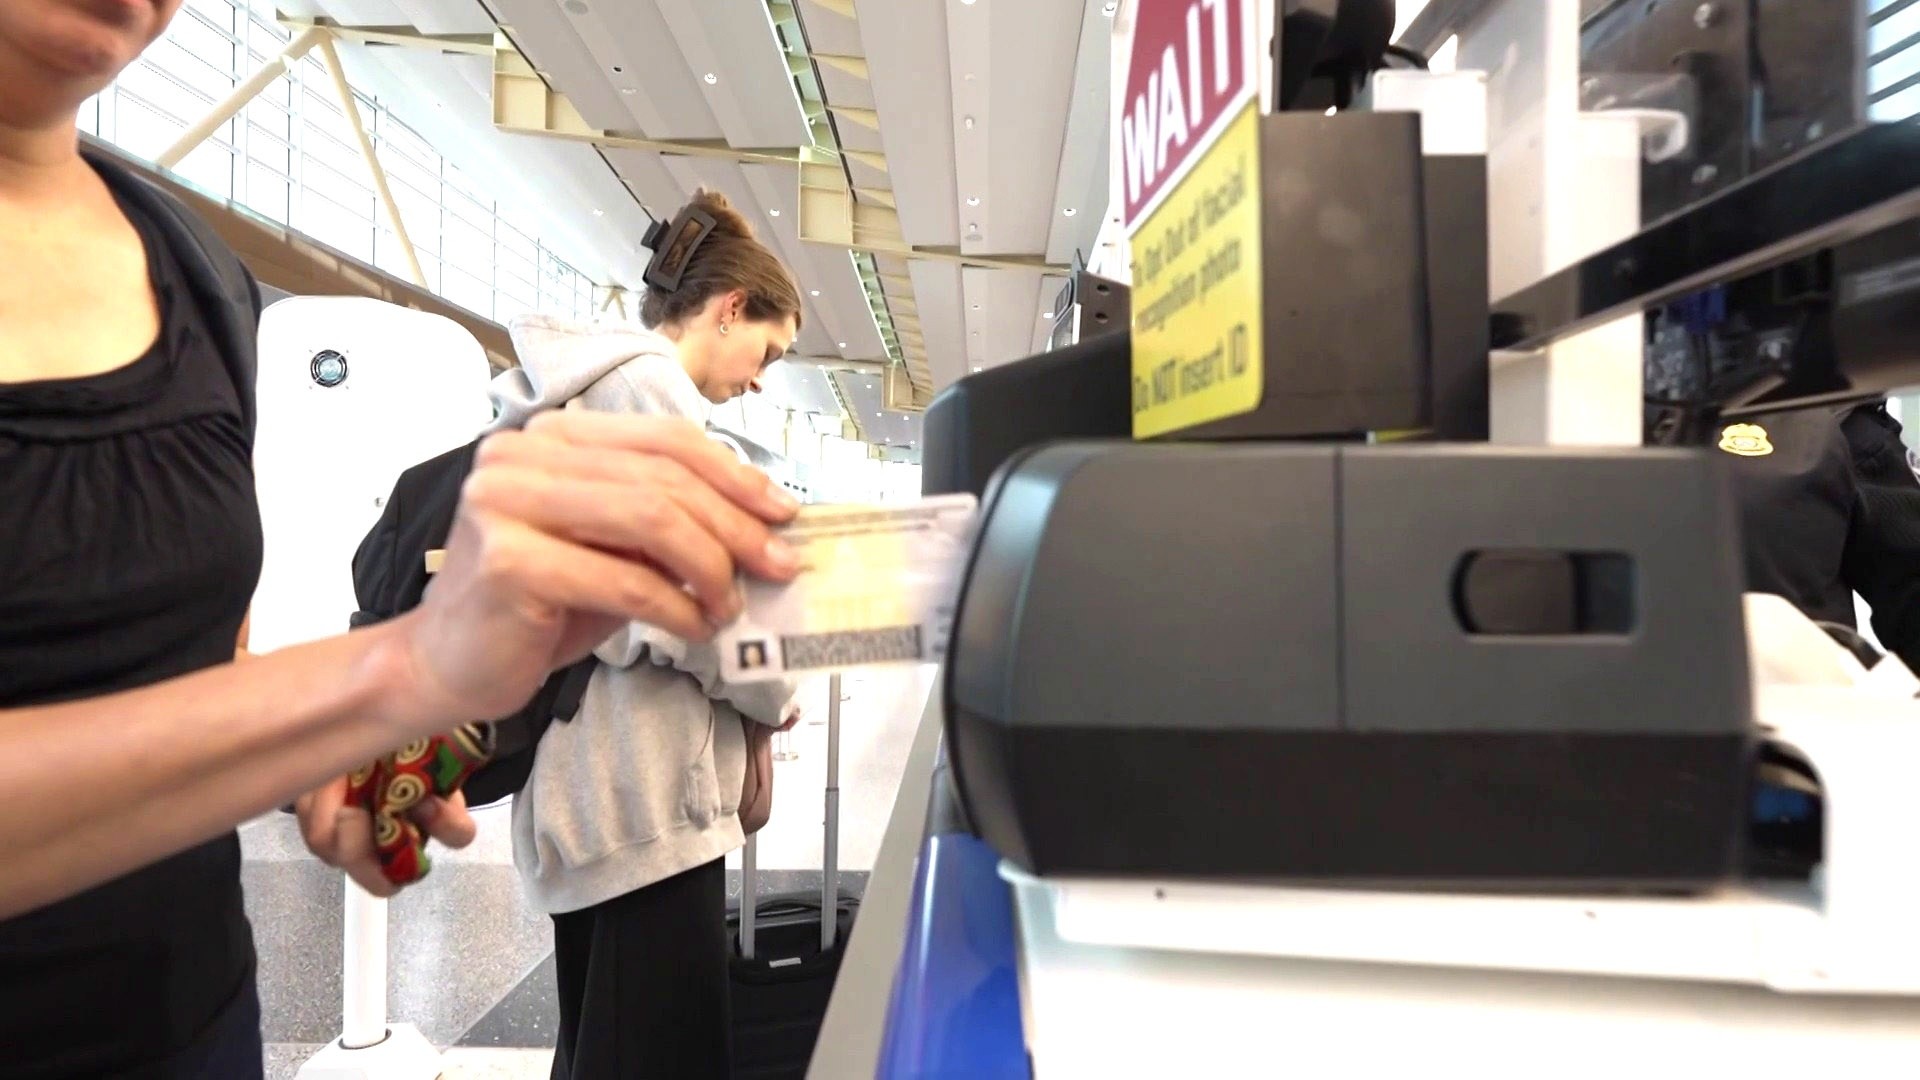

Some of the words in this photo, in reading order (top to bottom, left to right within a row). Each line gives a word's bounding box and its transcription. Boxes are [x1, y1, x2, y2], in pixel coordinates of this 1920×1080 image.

[1123, 0, 1230, 204] WAIT
[1165, 219, 1185, 265] Out
[1187, 200, 1200, 244] of
[1202, 152, 1246, 228] facial
[1135, 272, 1196, 333] recognition
[1200, 237, 1242, 305] photo
[1151, 356, 1178, 406] NOT
[1180, 339, 1225, 398] insert
[1227, 321, 1249, 379] ID
